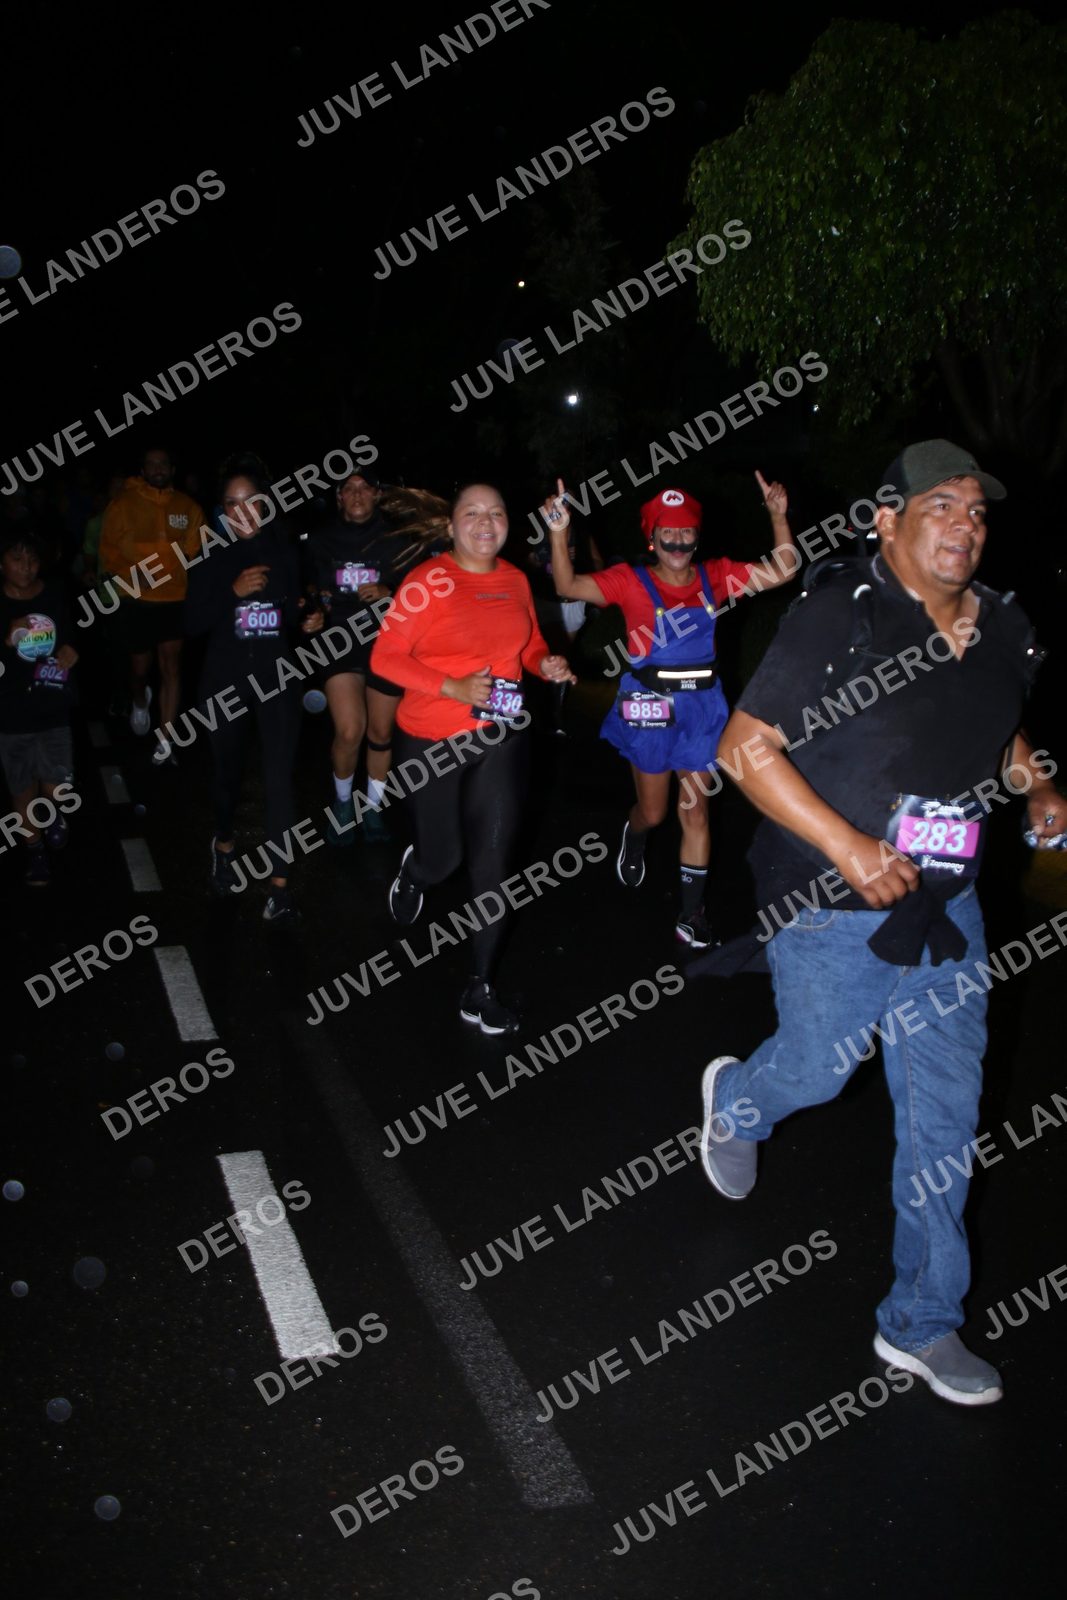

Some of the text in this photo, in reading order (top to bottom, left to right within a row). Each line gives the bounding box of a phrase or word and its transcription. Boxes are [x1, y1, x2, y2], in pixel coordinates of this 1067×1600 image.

[342, 570, 369, 584] 812
[248, 611, 277, 628] 600
[629, 702, 662, 719] 985
[909, 820, 967, 853] 283
